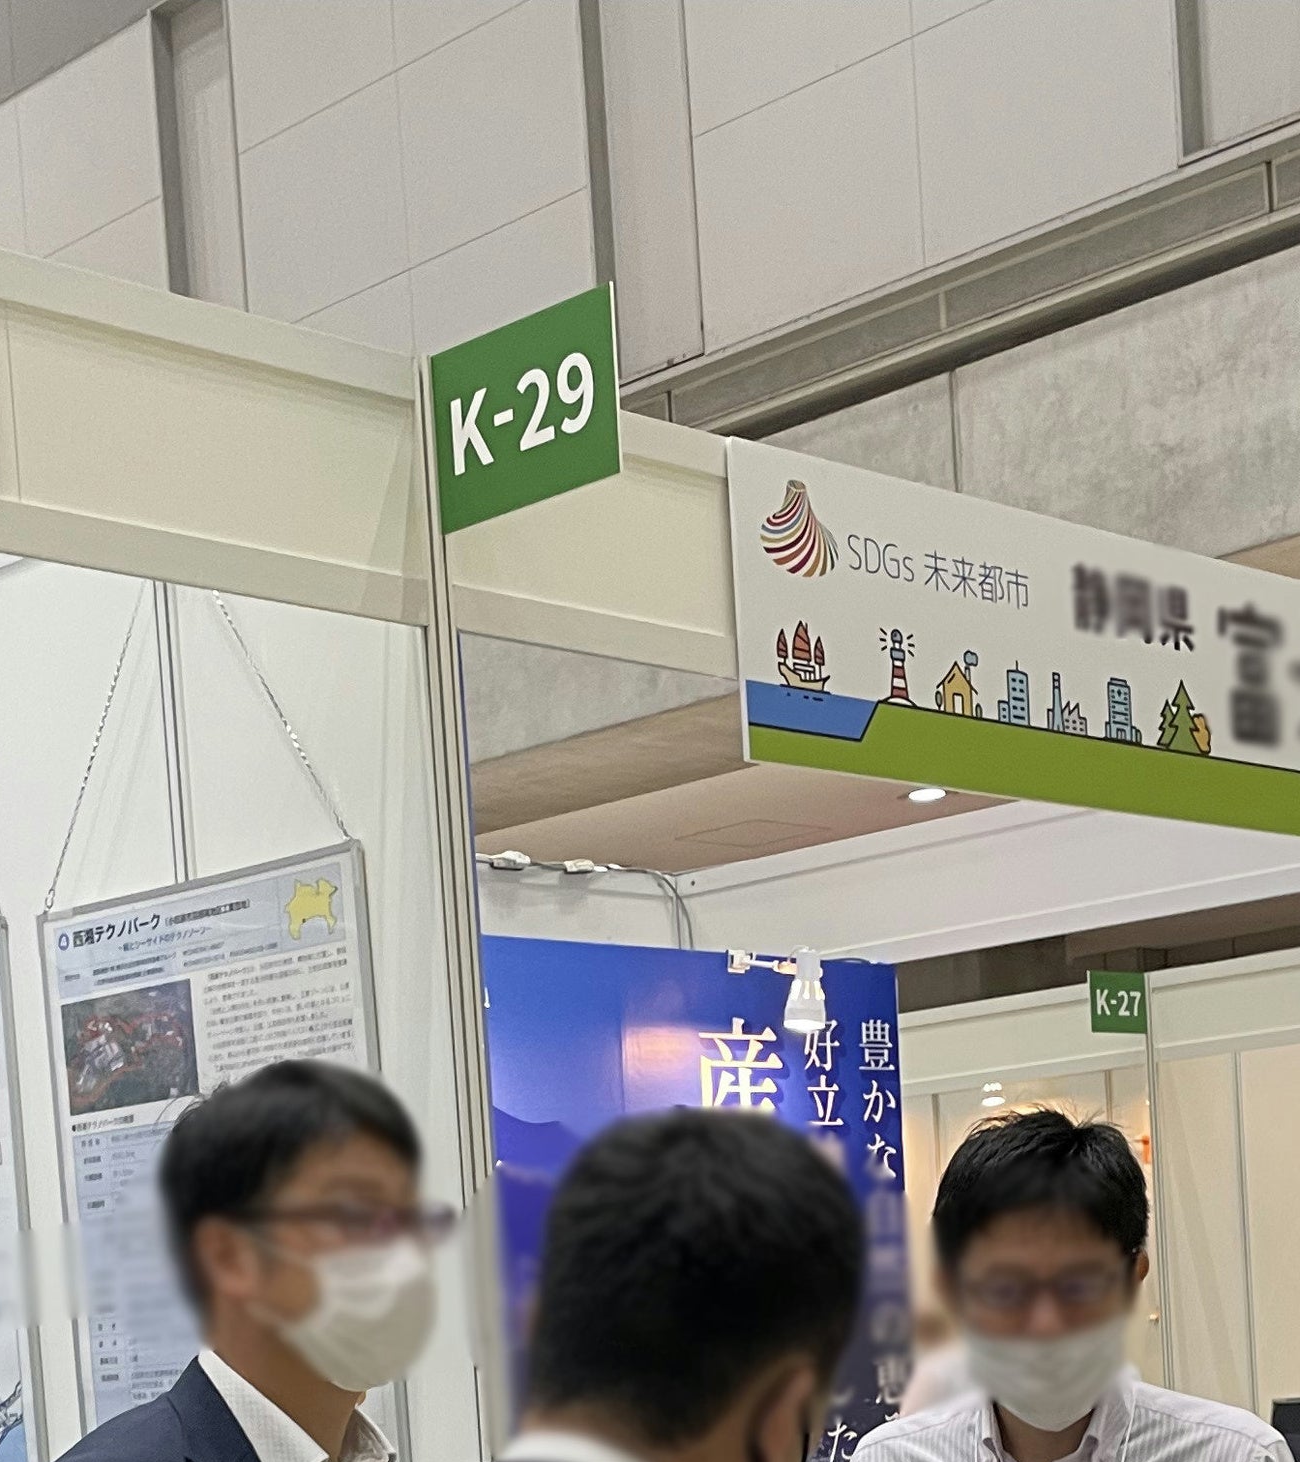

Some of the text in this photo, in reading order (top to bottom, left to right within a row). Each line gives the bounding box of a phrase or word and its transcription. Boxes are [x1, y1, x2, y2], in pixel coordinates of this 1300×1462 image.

[449, 351, 596, 476] K-29
[846, 533, 1029, 608] SDGs 未来都市
[1095, 987, 1141, 1017] K-27
